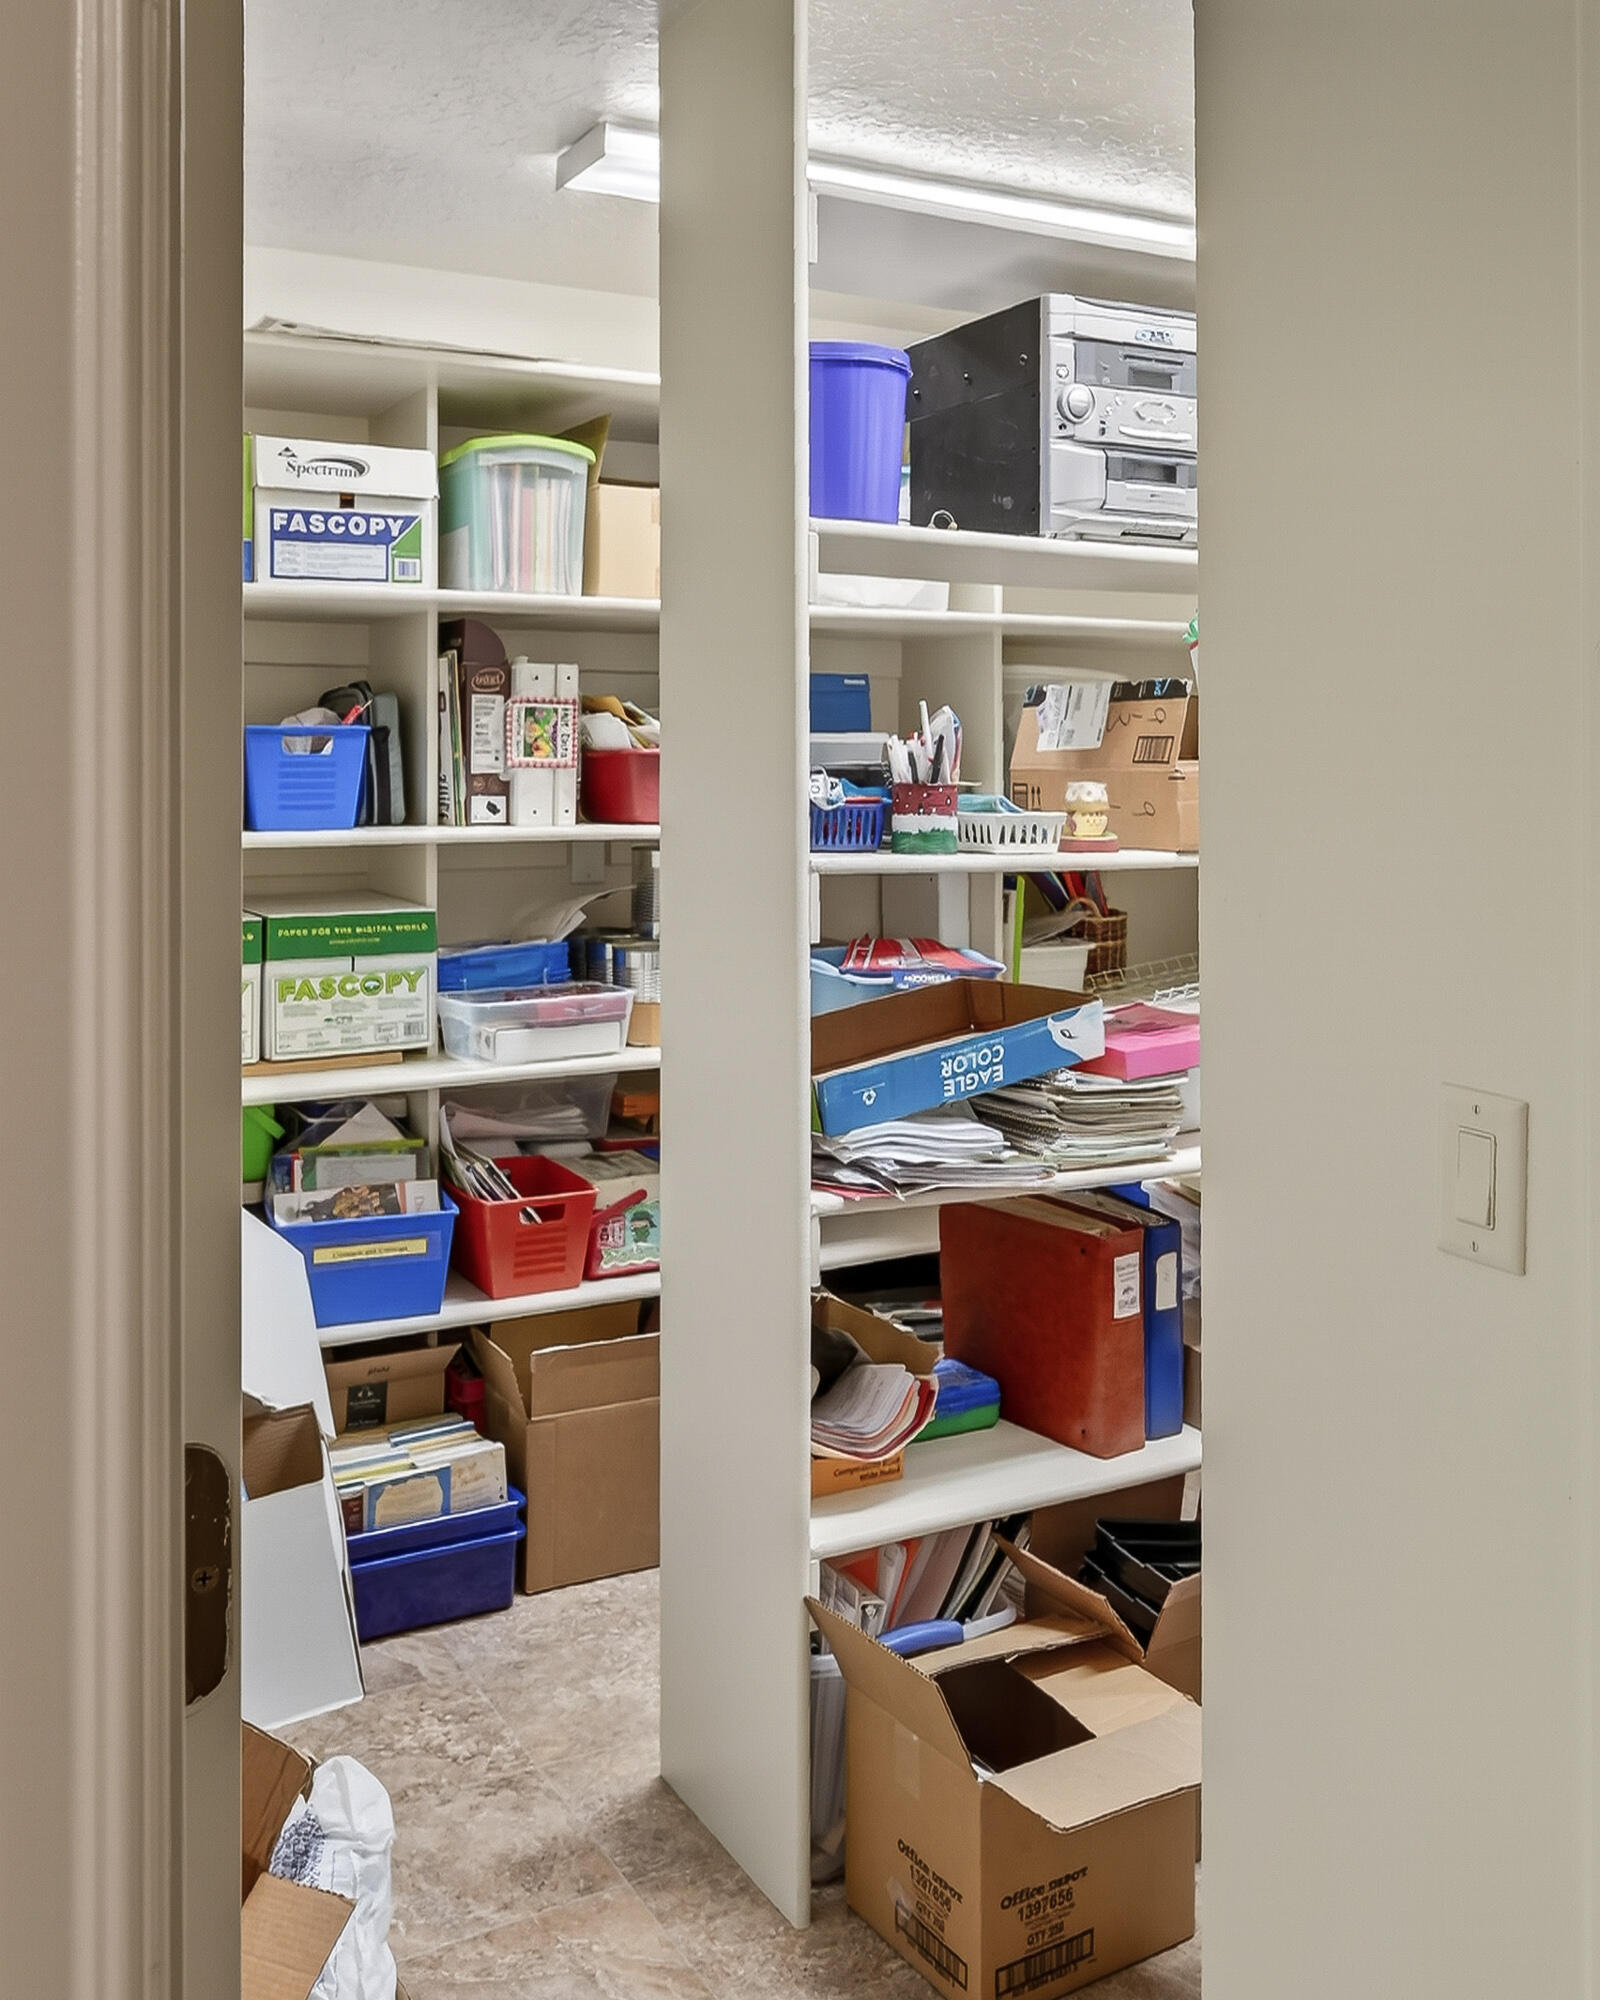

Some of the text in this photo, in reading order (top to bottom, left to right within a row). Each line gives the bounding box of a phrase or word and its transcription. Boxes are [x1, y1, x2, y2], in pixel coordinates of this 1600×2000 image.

[285, 459, 361, 479] Spectrum
[273, 512, 405, 537] FASCOPY
[277, 969, 427, 1004] FASCOPY
[940, 1044, 1005, 1078] COLOR
[943, 1064, 1004, 1098] EAGLE
[1000, 1865, 1089, 1911] Office DEPOT
[1017, 1886, 1074, 1923] 1397656
